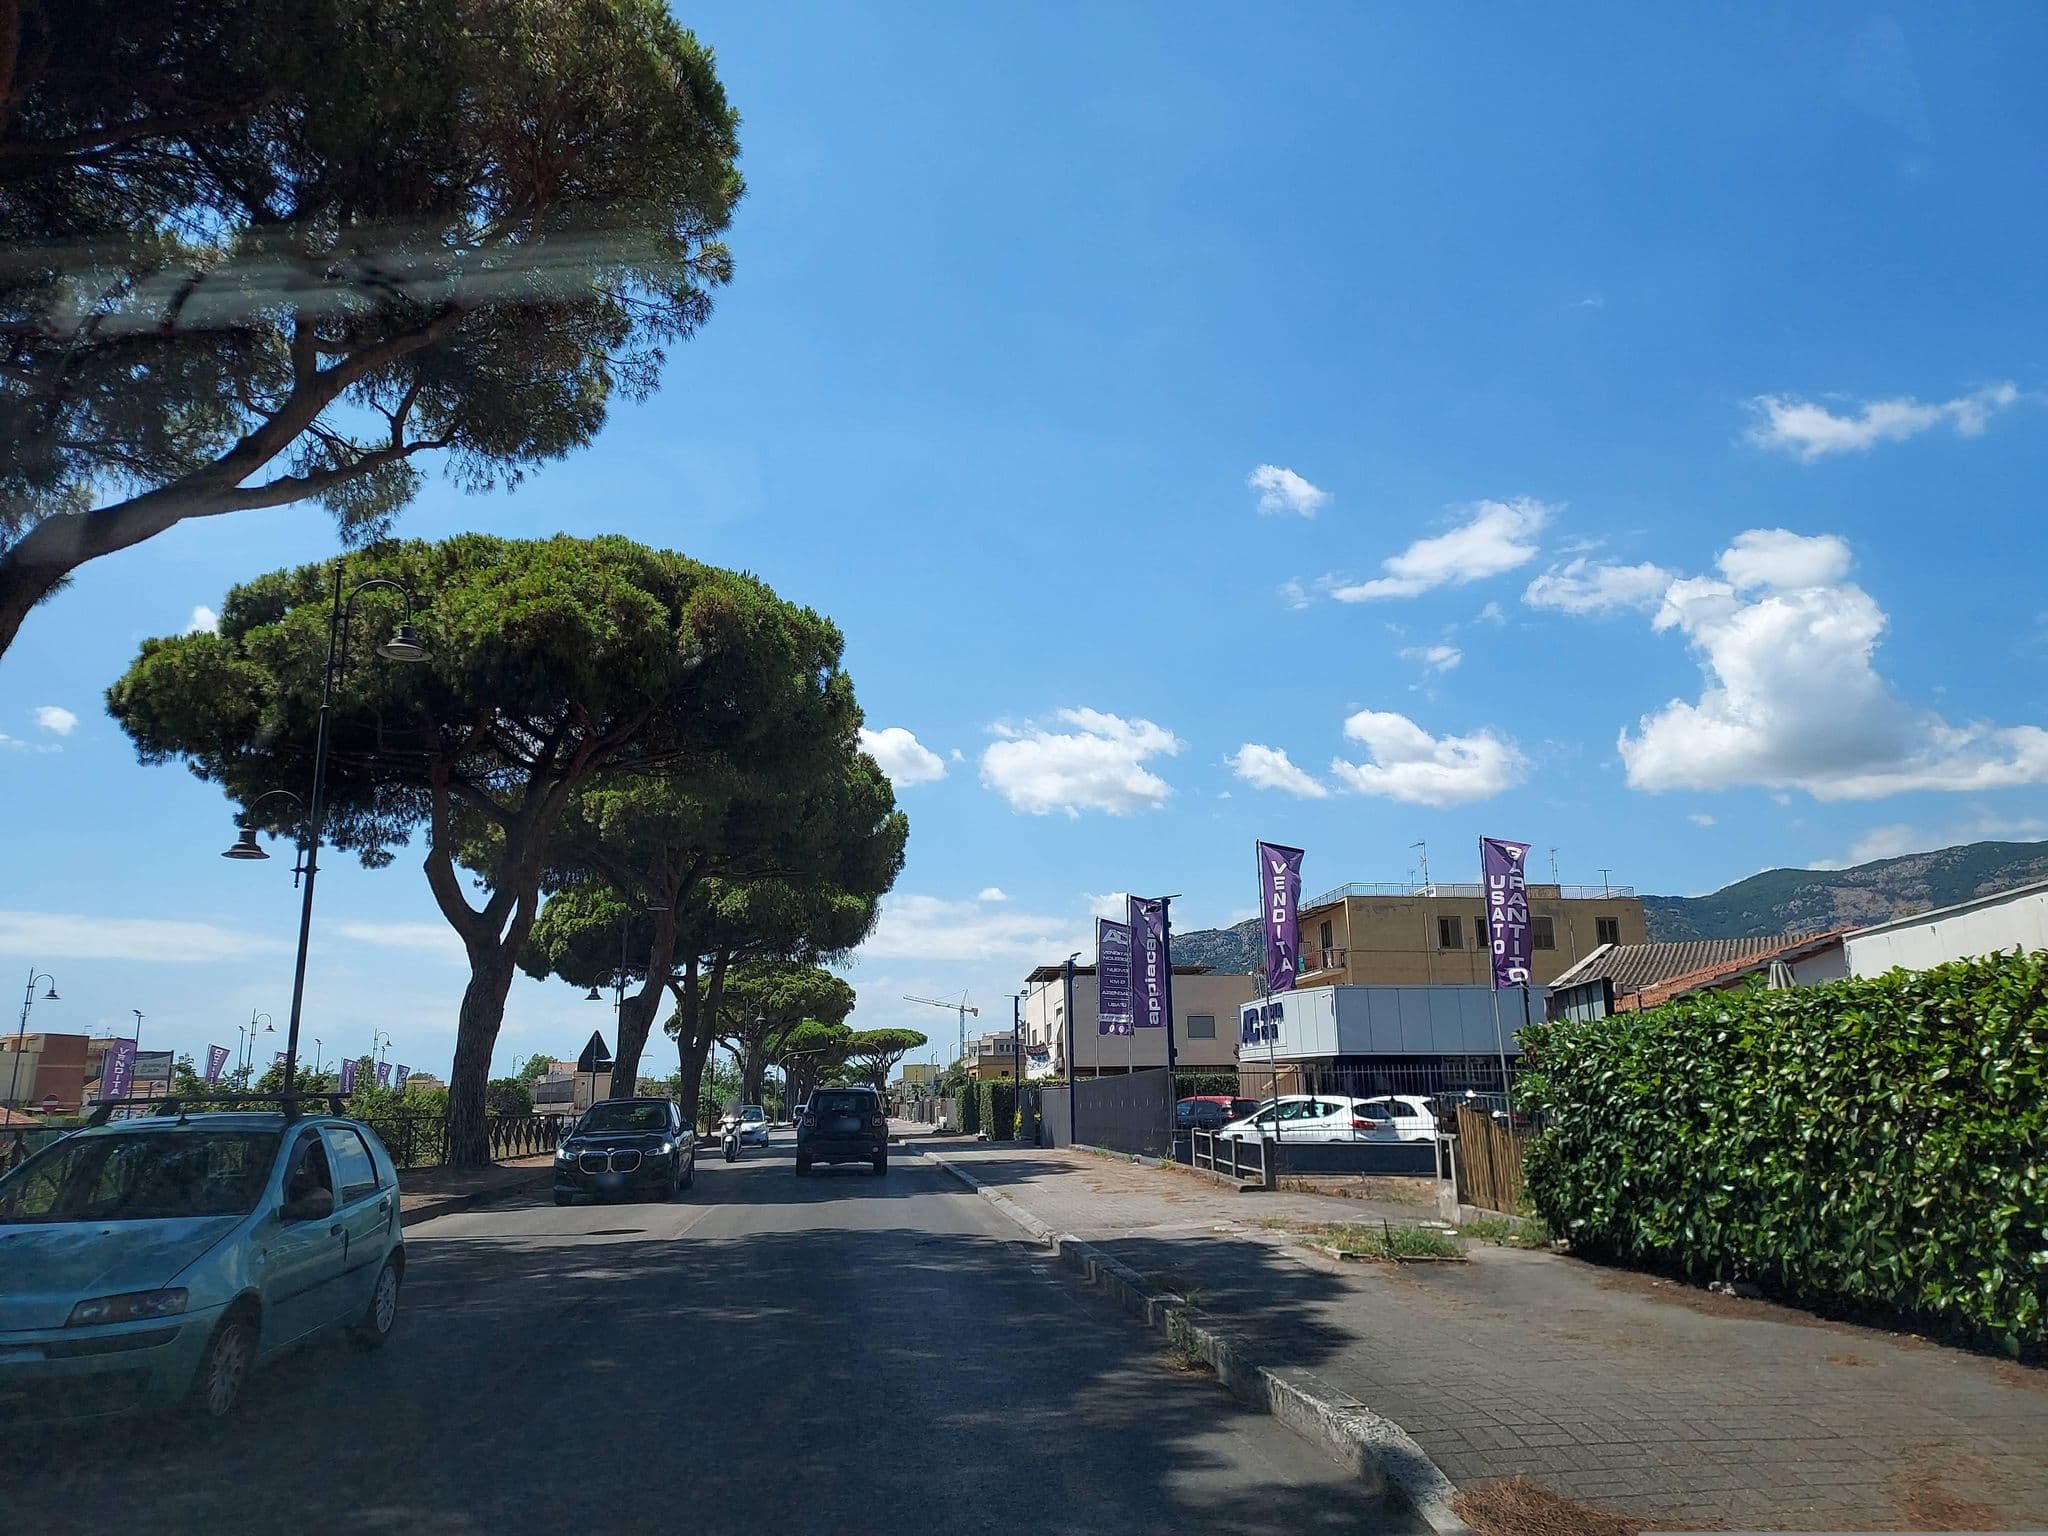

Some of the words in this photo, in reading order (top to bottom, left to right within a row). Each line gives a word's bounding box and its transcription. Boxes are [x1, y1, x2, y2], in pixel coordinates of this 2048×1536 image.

[1271, 860, 1293, 972] VENDITA
[1490, 875, 1505, 955] USATO
[1505, 847, 1529, 983] GARANTITO
[110, 1047, 129, 1095] VENDITA
